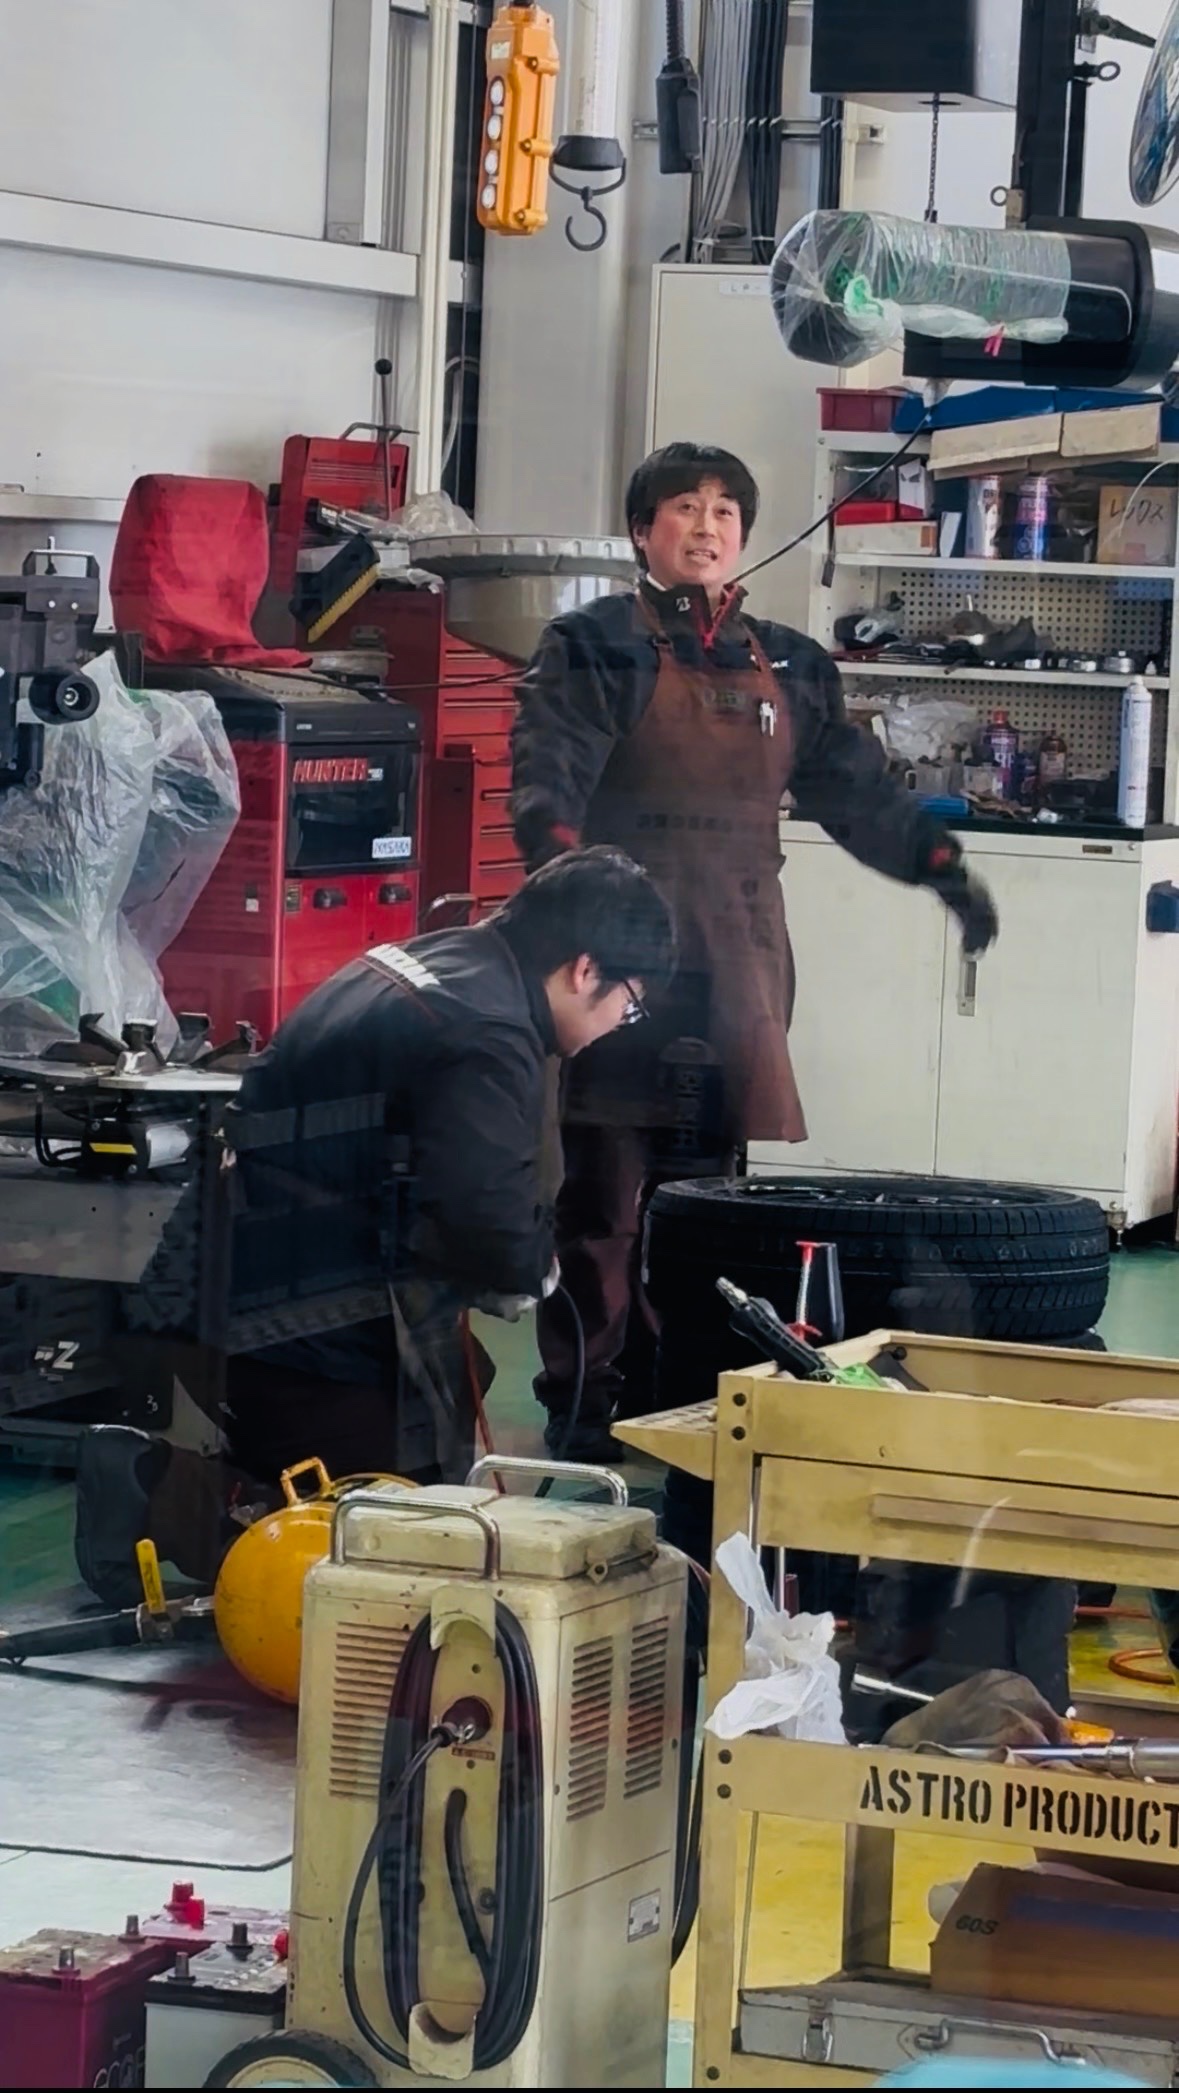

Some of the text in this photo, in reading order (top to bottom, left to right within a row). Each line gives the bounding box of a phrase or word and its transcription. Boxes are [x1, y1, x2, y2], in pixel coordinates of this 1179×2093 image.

[292, 758, 368, 782] HUNTER
[860, 1765, 1179, 1849] ASTRO PRODUCT
